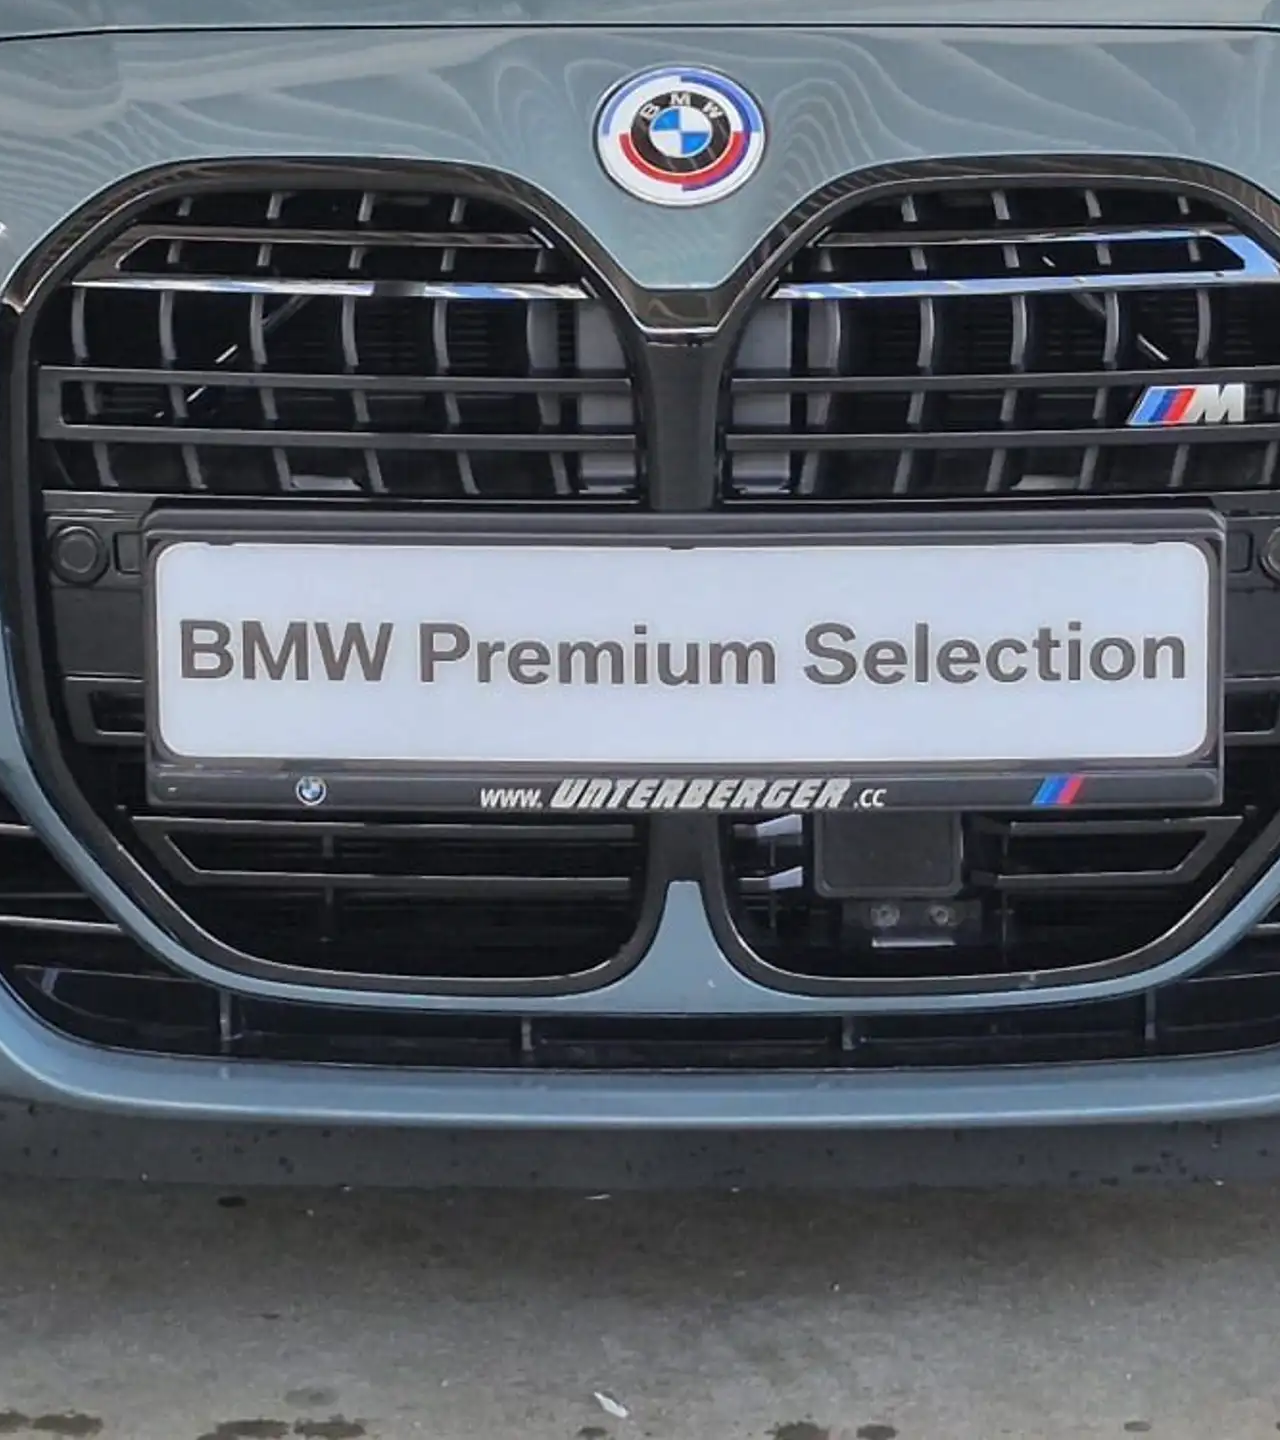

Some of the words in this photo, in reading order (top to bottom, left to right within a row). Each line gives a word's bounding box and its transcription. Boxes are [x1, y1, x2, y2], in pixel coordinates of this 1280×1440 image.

[639, 92, 724, 120] BMW
[178, 618, 394, 682] BMW
[418, 621, 776, 686] Premium
[803, 620, 1186, 685] Selection
